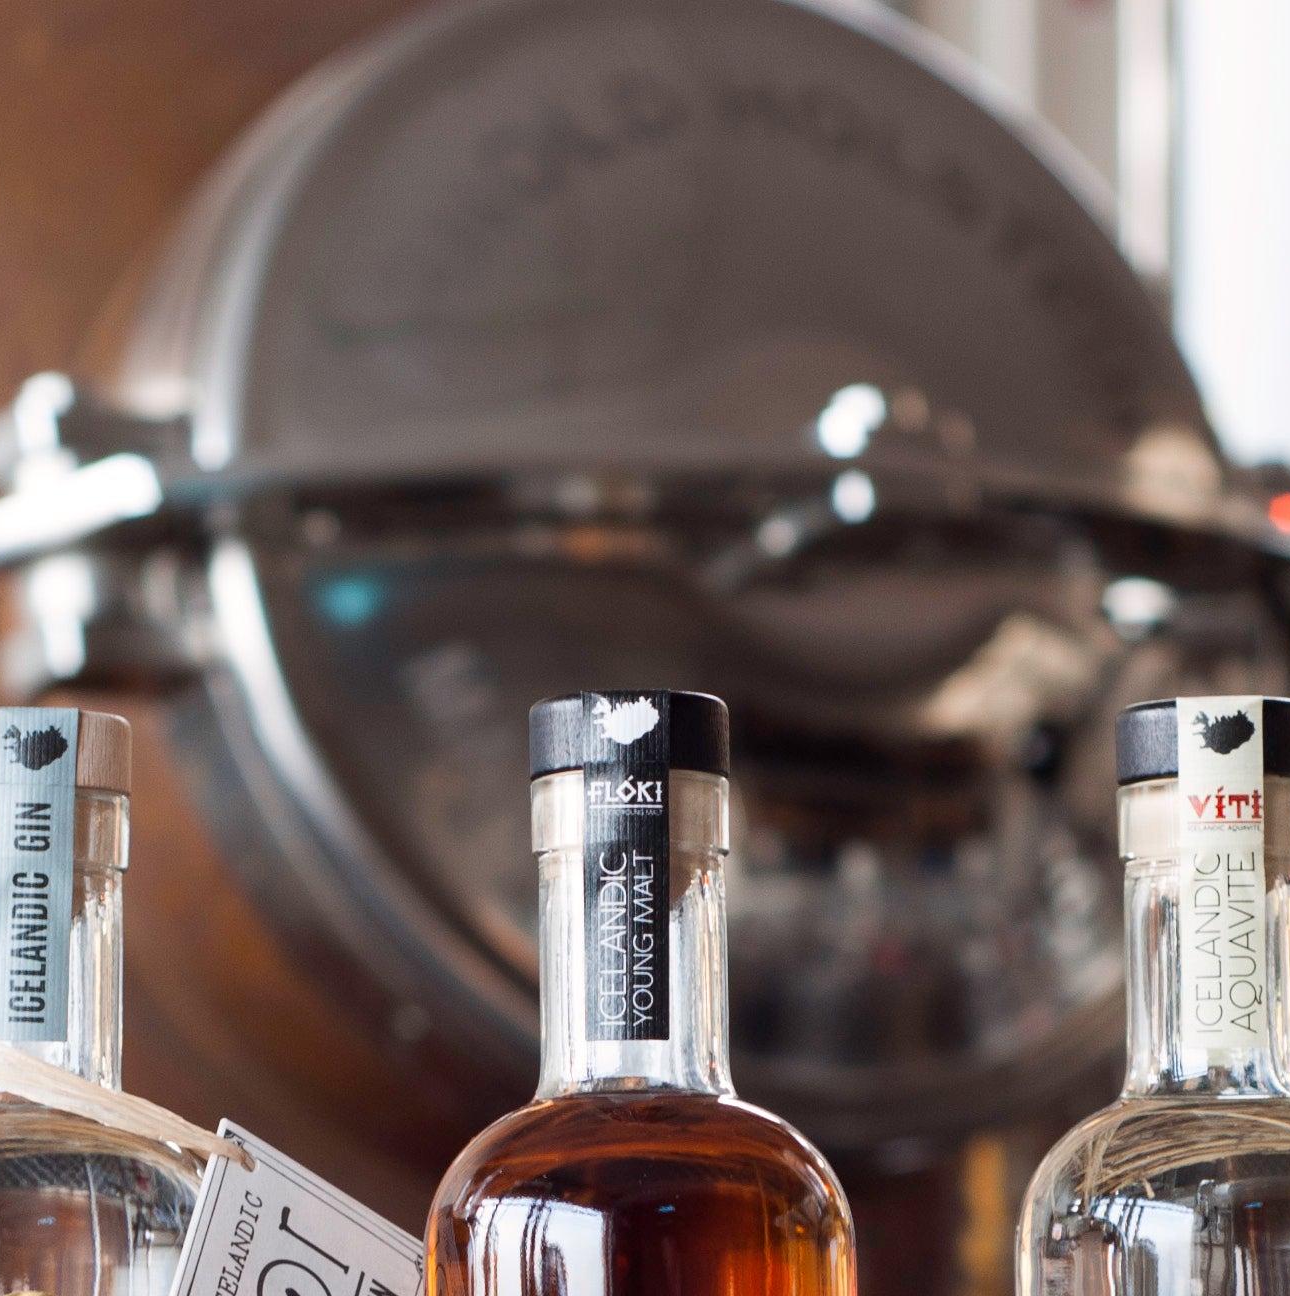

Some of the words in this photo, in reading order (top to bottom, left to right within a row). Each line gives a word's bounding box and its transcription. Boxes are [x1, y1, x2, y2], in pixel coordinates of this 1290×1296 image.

[14, 802, 51, 852] GIN
[587, 774, 662, 803] FLÓKI
[8, 871, 49, 1023] ICELANDIC
[599, 851, 627, 1027] ICELANDIC
[633, 850, 654, 925] MALT
[1194, 853, 1222, 1033] ICELANDIC
[1228, 851, 1262, 1033] AQUAVITE
[633, 934, 654, 1027] YOUNG
